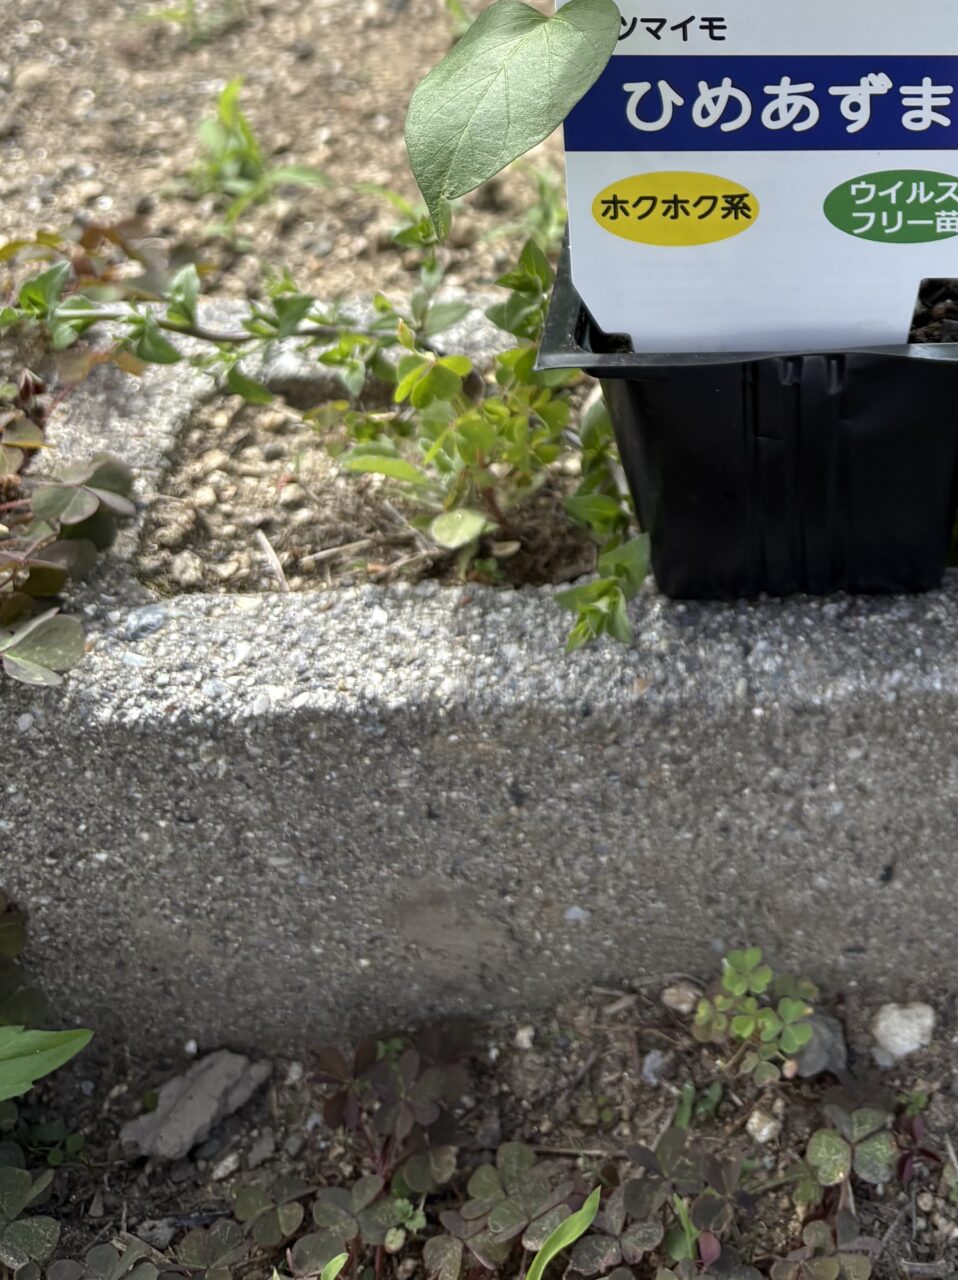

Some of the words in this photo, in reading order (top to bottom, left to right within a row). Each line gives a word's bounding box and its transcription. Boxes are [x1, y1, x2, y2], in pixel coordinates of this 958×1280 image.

[622, 72, 954, 133] ひめあずま
[600, 193, 753, 221] ホクホク系
